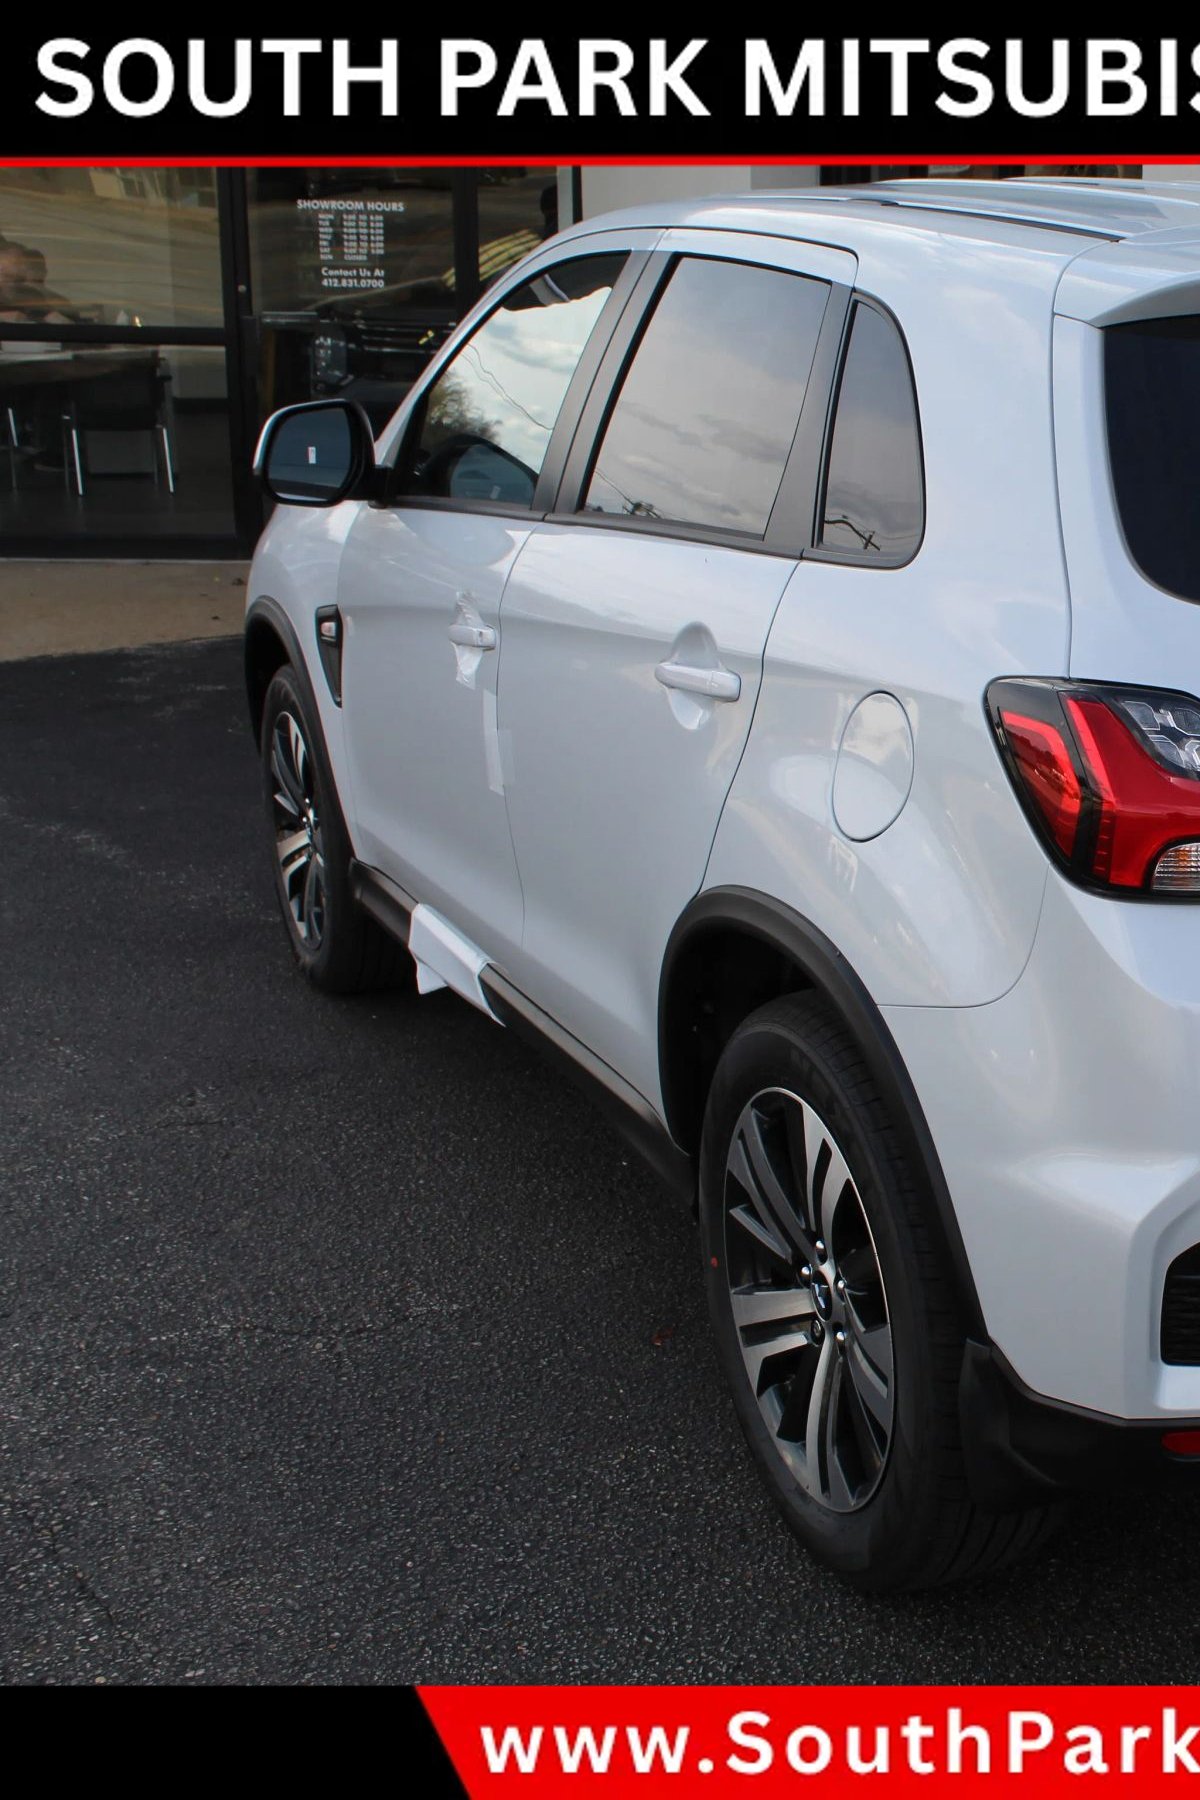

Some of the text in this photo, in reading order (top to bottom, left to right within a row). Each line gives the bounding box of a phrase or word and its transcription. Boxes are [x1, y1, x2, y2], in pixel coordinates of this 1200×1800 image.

[296, 199, 405, 212] SHOWROOM HOURS
[321, 267, 385, 277] Contact Us At
[321, 278, 385, 288] 412.831.0700
